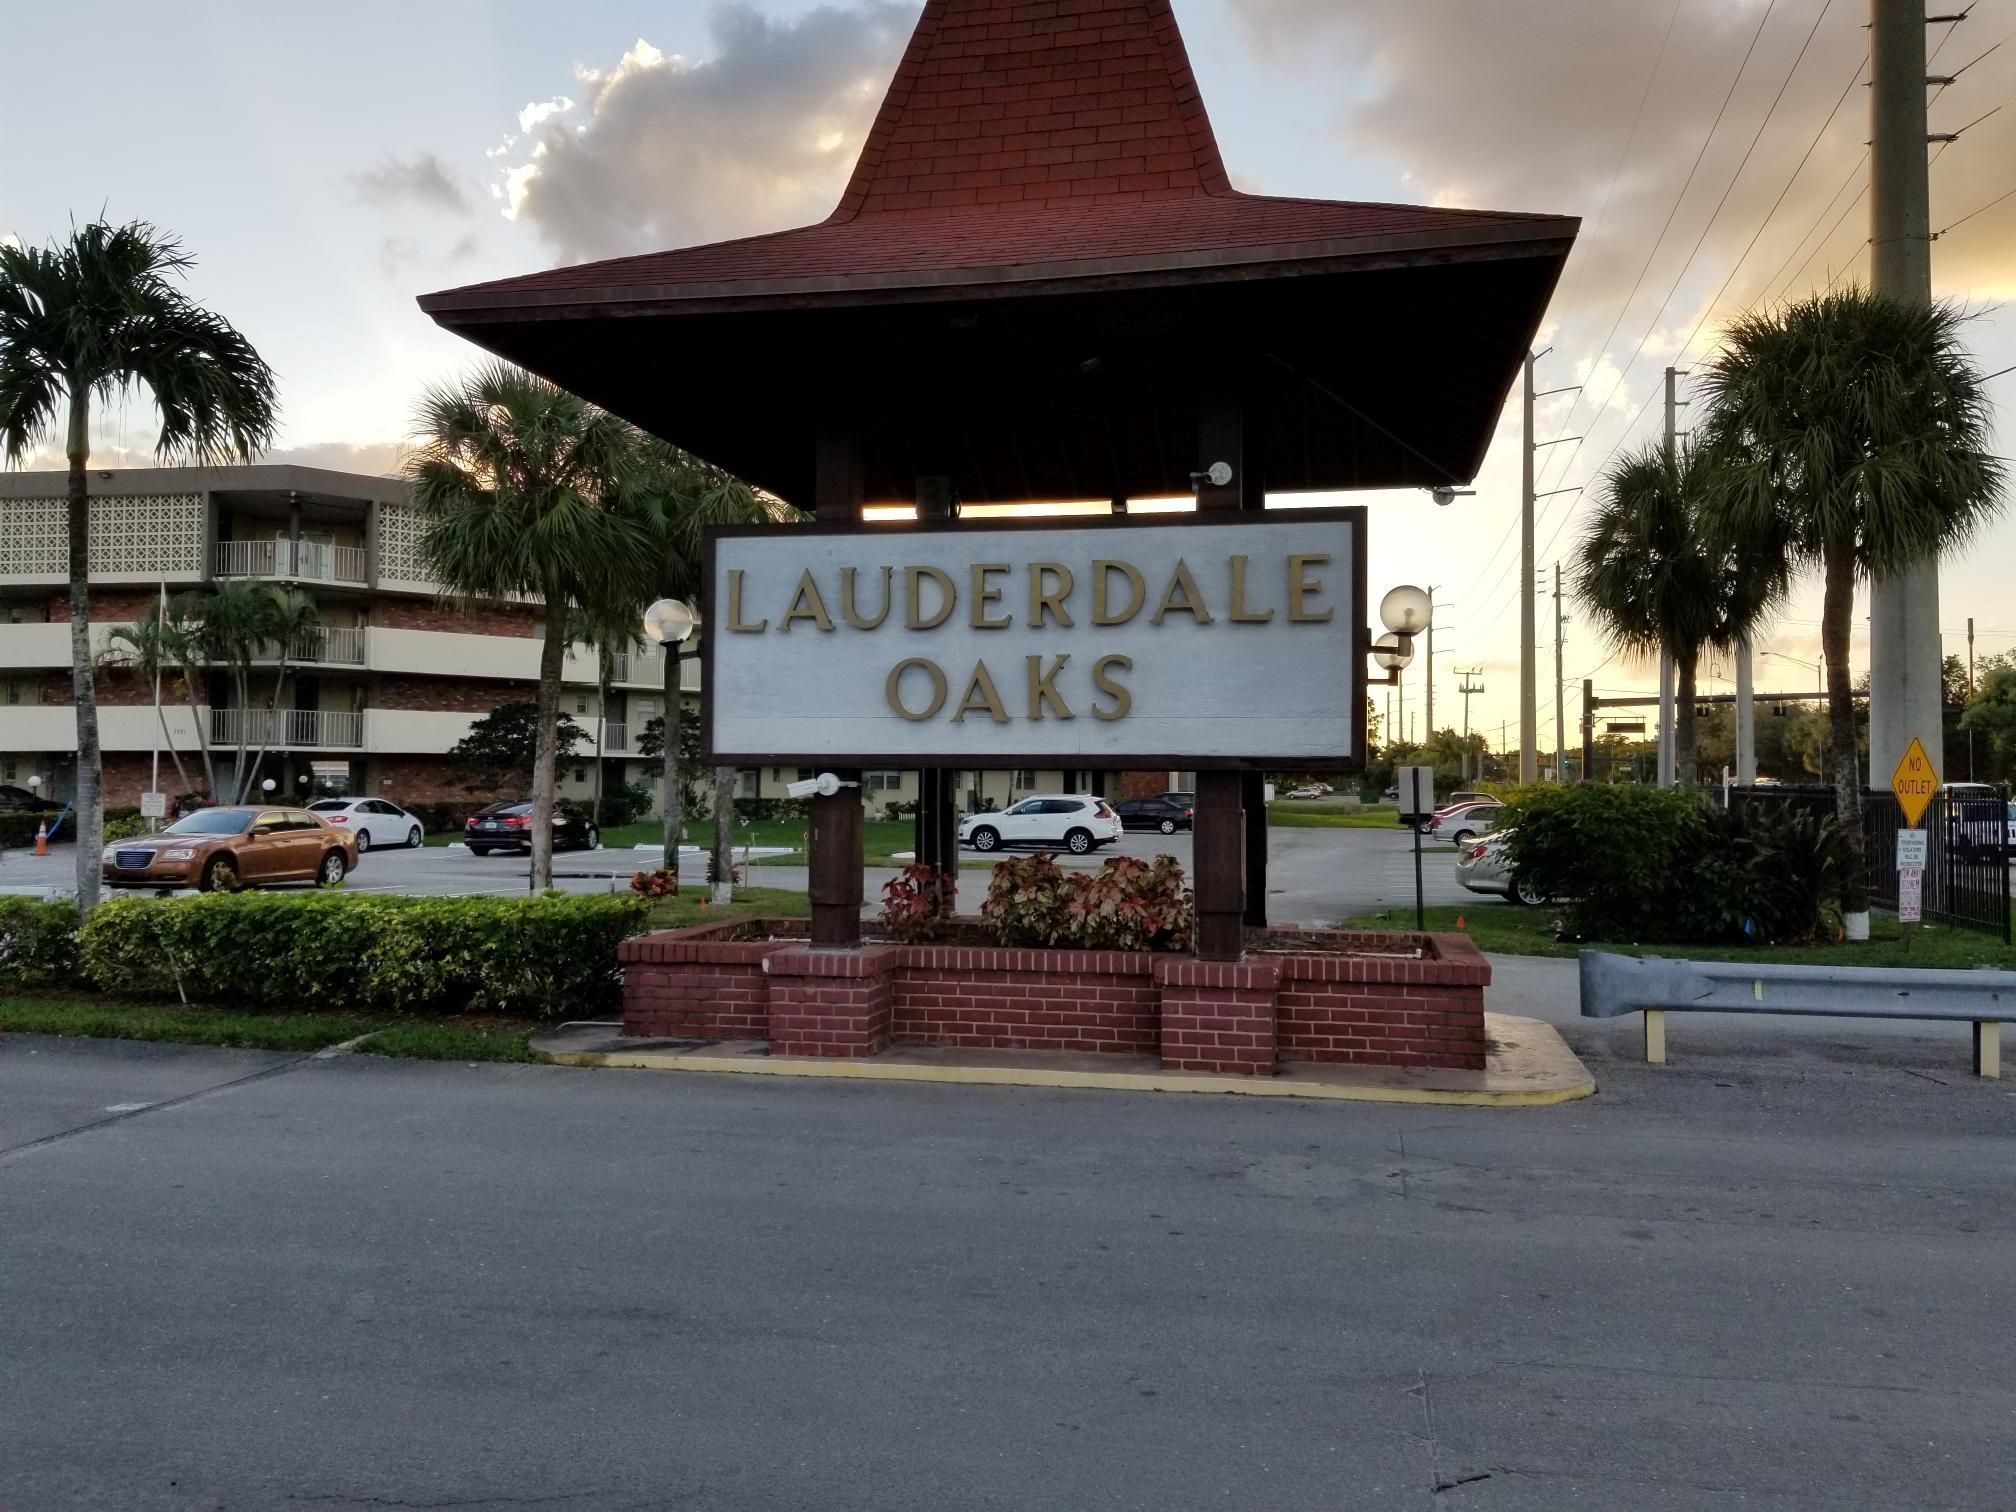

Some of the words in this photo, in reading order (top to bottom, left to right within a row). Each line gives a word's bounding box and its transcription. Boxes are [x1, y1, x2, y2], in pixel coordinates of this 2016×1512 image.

[725, 553, 1335, 632] LAUDERDALE
[884, 654, 1134, 722] OAKS
[1909, 757, 1922, 771] NO
[1898, 779, 1932, 795] OUTLET
